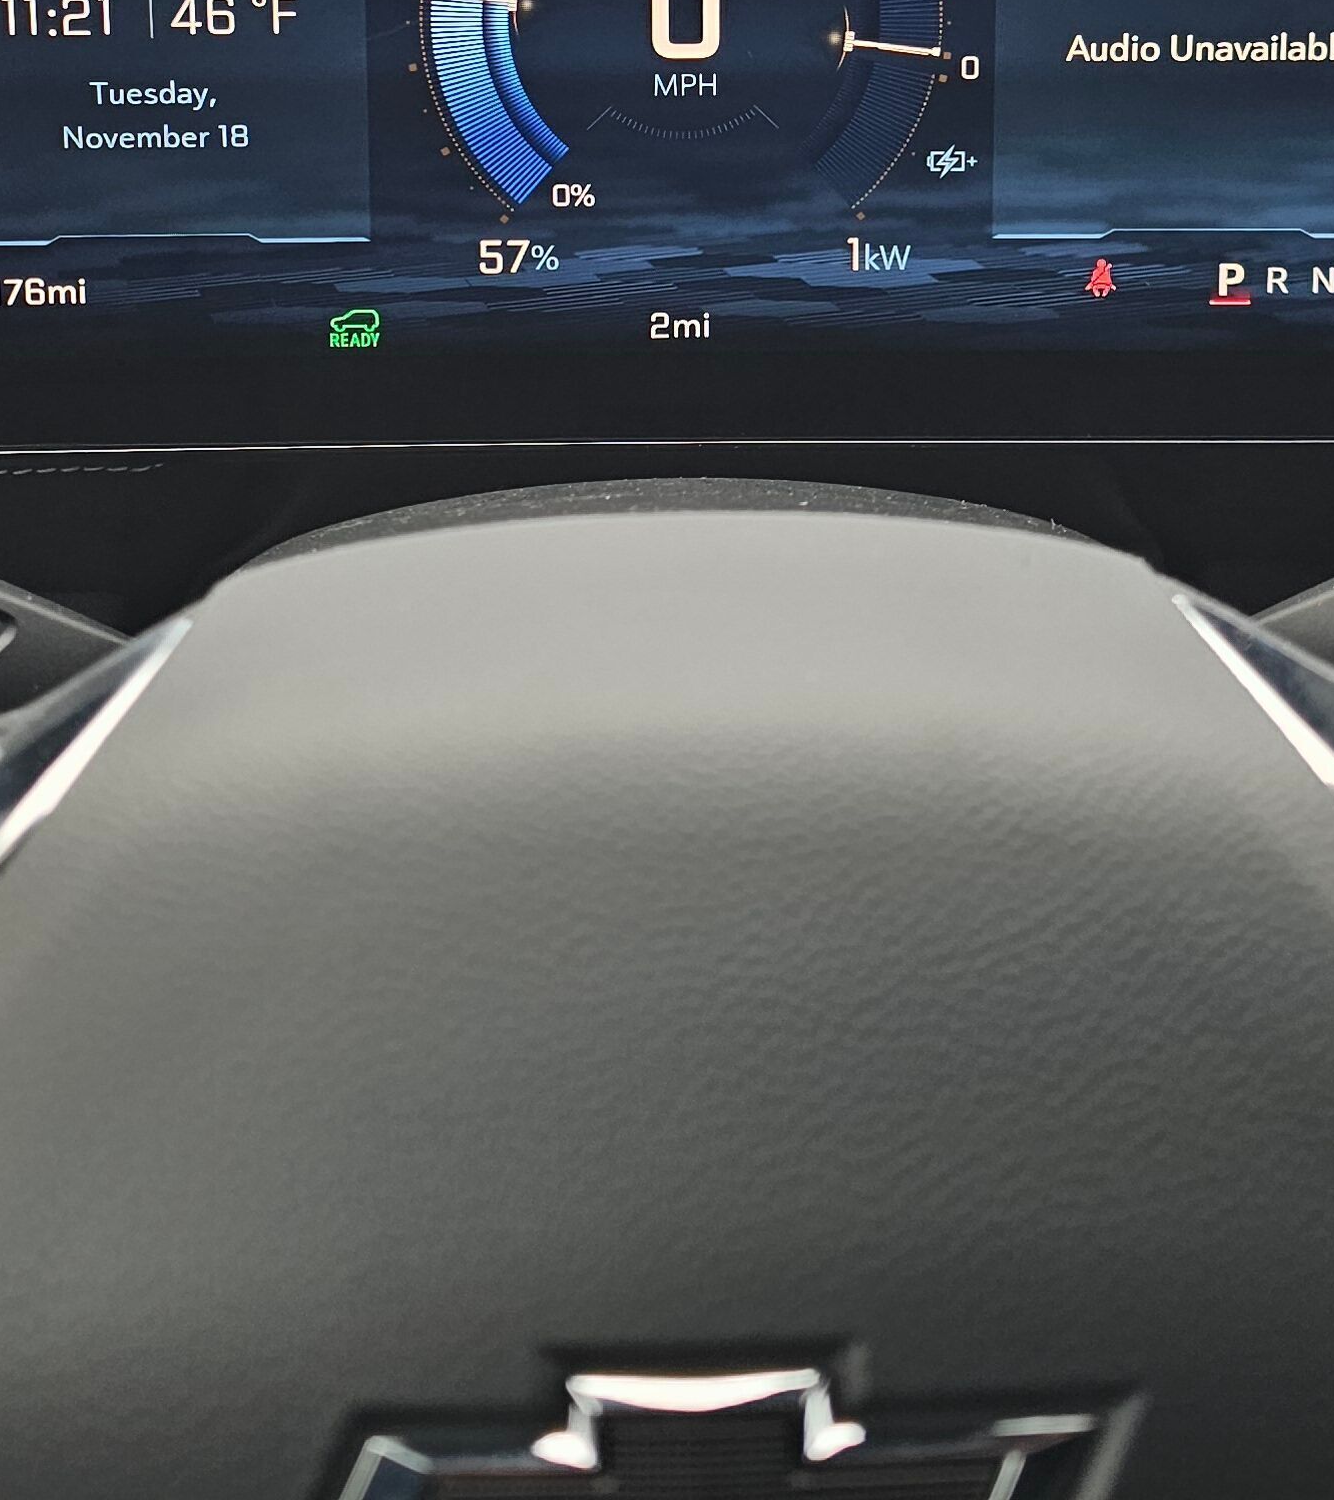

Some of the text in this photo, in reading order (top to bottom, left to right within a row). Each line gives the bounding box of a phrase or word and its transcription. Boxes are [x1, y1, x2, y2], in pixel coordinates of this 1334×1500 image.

[1066, 33, 1160, 61] Audio
[962, 56, 979, 79] 0
[89, 80, 216, 110] Tuesday,
[654, 73, 716, 96] MPH
[64, 124, 248, 148] November 18
[553, 184, 595, 206] 0%
[480, 240, 559, 274] 57%
[1218, 263, 1245, 296] P
[1267, 267, 1288, 294] R
[1312, 267, 1334, 293] N
[651, 312, 709, 339] 2mi
[329, 332, 380, 348] READY
